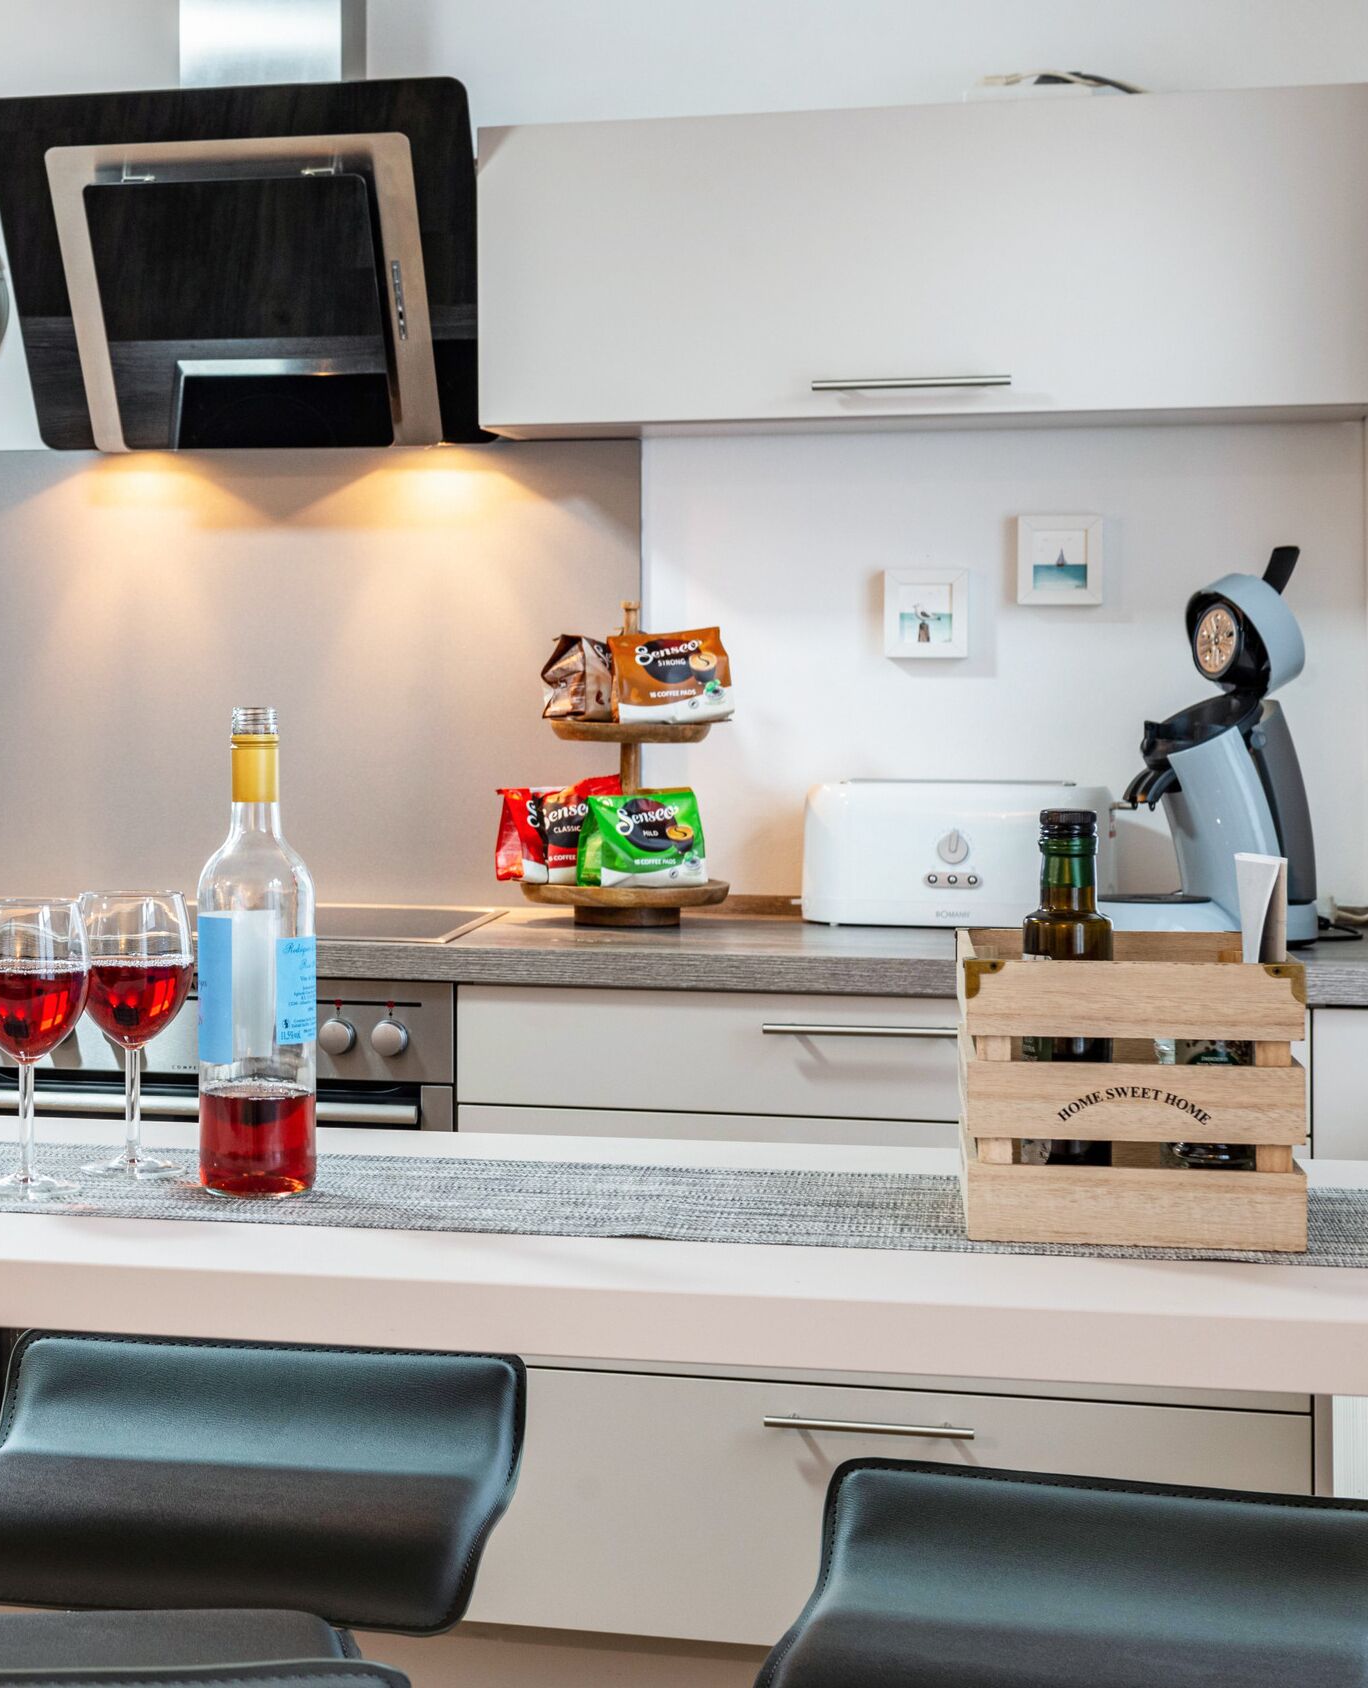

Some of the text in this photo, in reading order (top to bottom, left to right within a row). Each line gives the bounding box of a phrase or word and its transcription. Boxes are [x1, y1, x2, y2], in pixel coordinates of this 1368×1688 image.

[635, 639, 702, 666] Senseo
[657, 658, 686, 667] STRONG
[657, 690, 679, 698] COFFEE
[616, 804, 679, 836] Senseo
[553, 825, 582, 834] CLASSIC
[643, 829, 659, 837] MILD
[554, 854, 576, 862] COFFEE
[1057, 1086, 1212, 1126] HOME SWEET HOME
